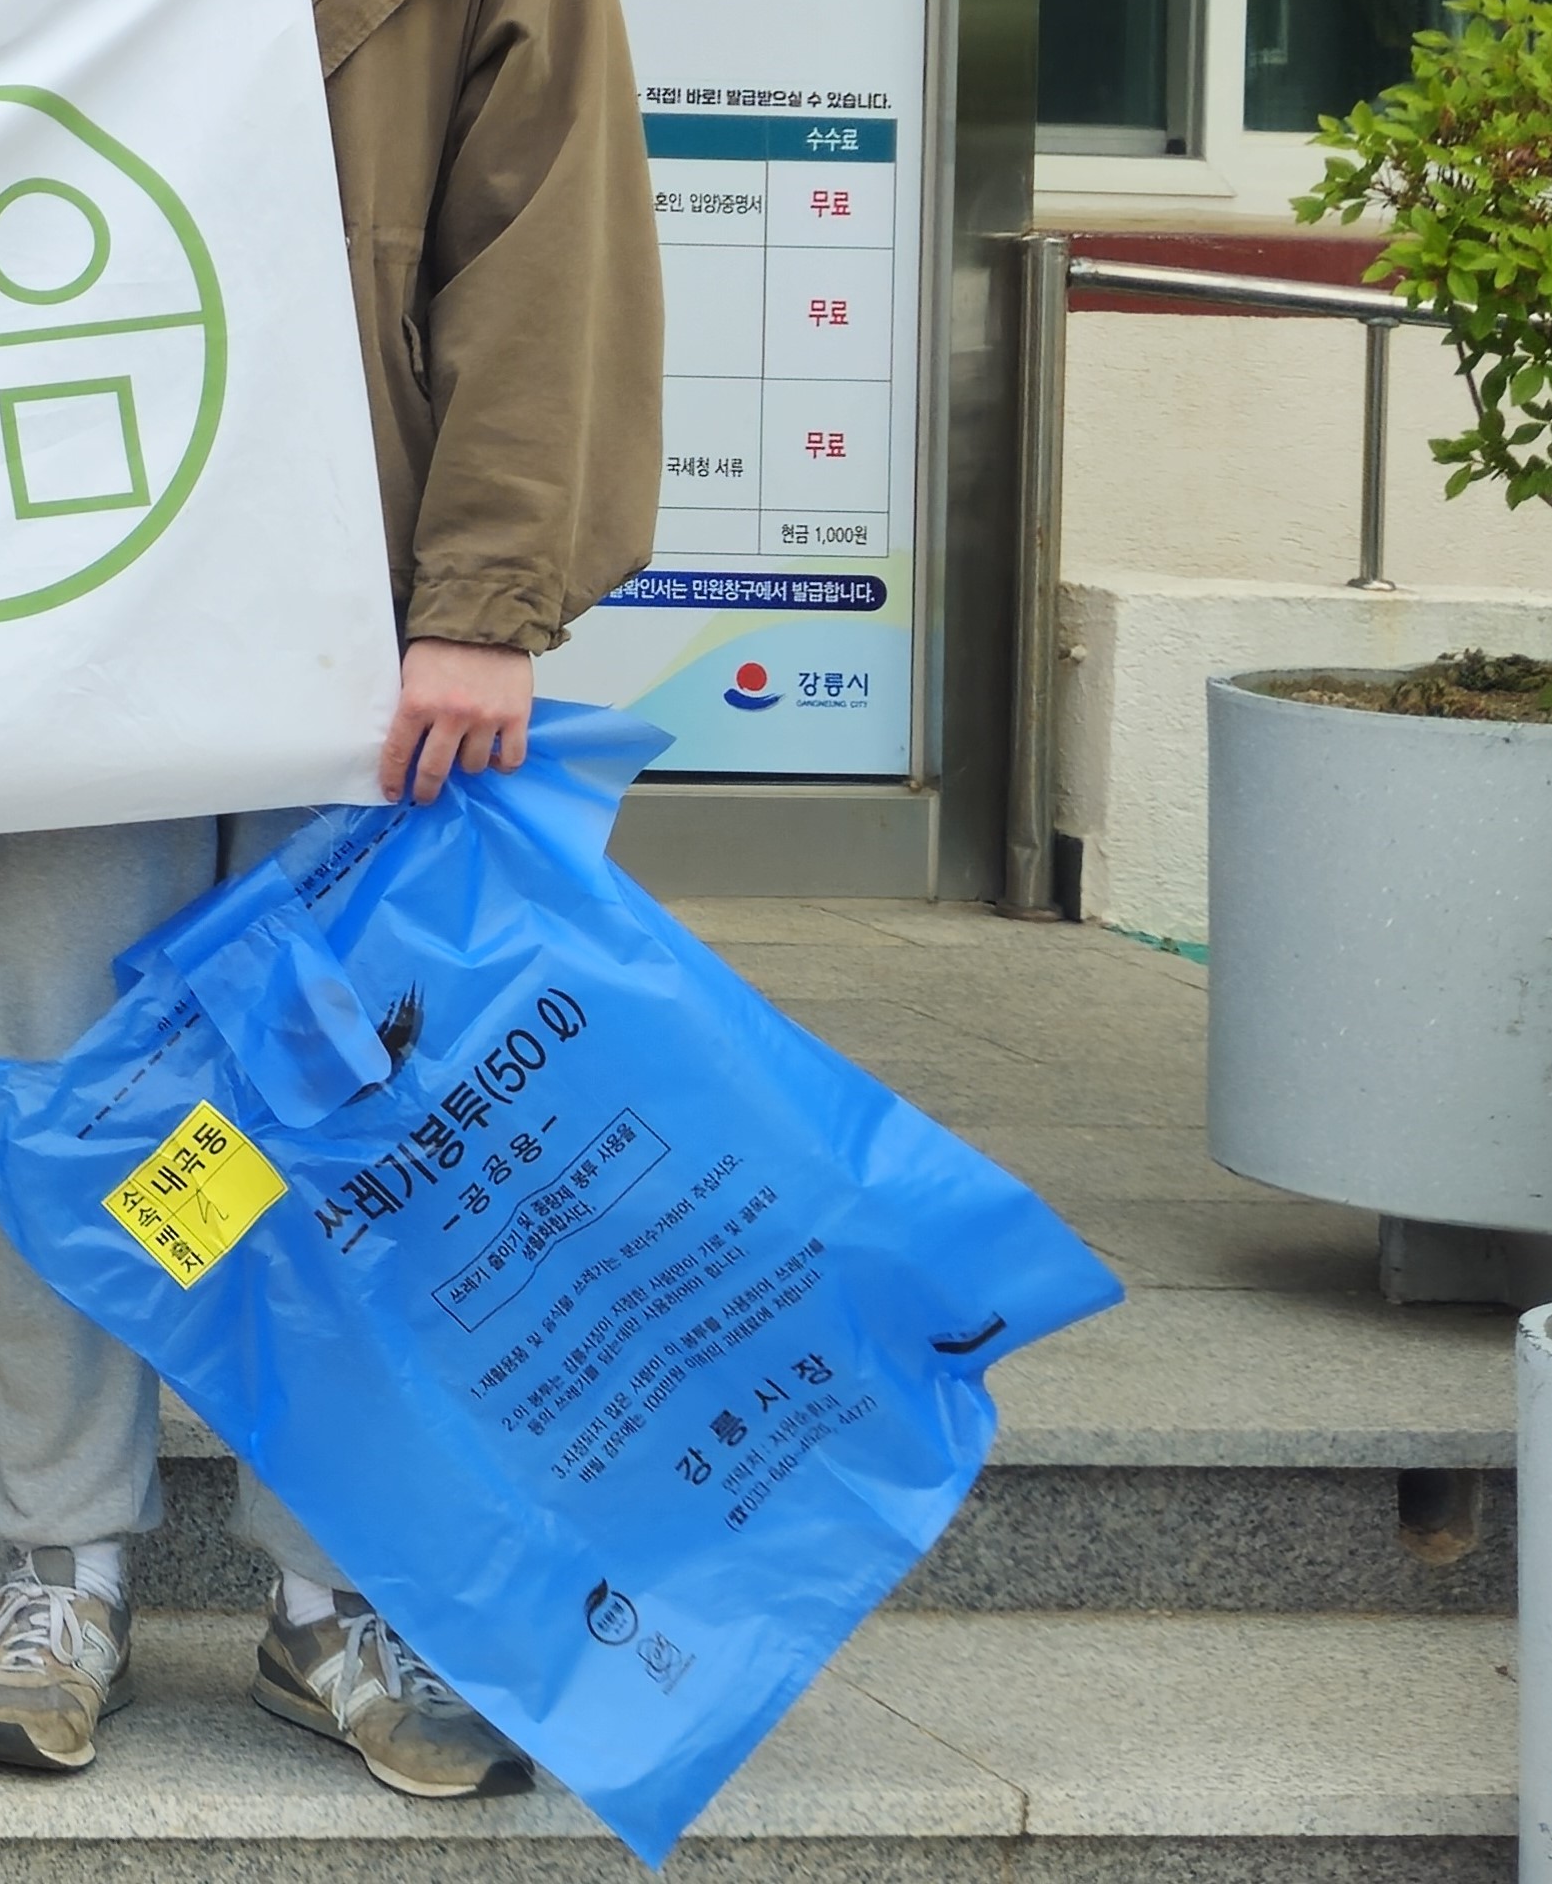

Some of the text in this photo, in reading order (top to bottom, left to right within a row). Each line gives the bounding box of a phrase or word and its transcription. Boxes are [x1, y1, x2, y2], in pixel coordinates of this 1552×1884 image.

[646, 88, 891, 109] 직접! 바로! 발급받으실 수 있습니다.
[806, 127, 859, 152] 수수료
[810, 190, 850, 217] 무료
[809, 300, 849, 327] 무료
[805, 432, 846, 459] 무료
[667, 457, 743, 477] 국세청 서류
[782, 524, 867, 545] 현금 1,000원
[693, 580, 787, 601] 민원창구에서
[792, 581, 875, 603] 발급합니다.
[798, 672, 868, 697] 강릉시
[151, 1121, 228, 1195] 내곡동
[449, 1265, 492, 1304] 쓰레기
